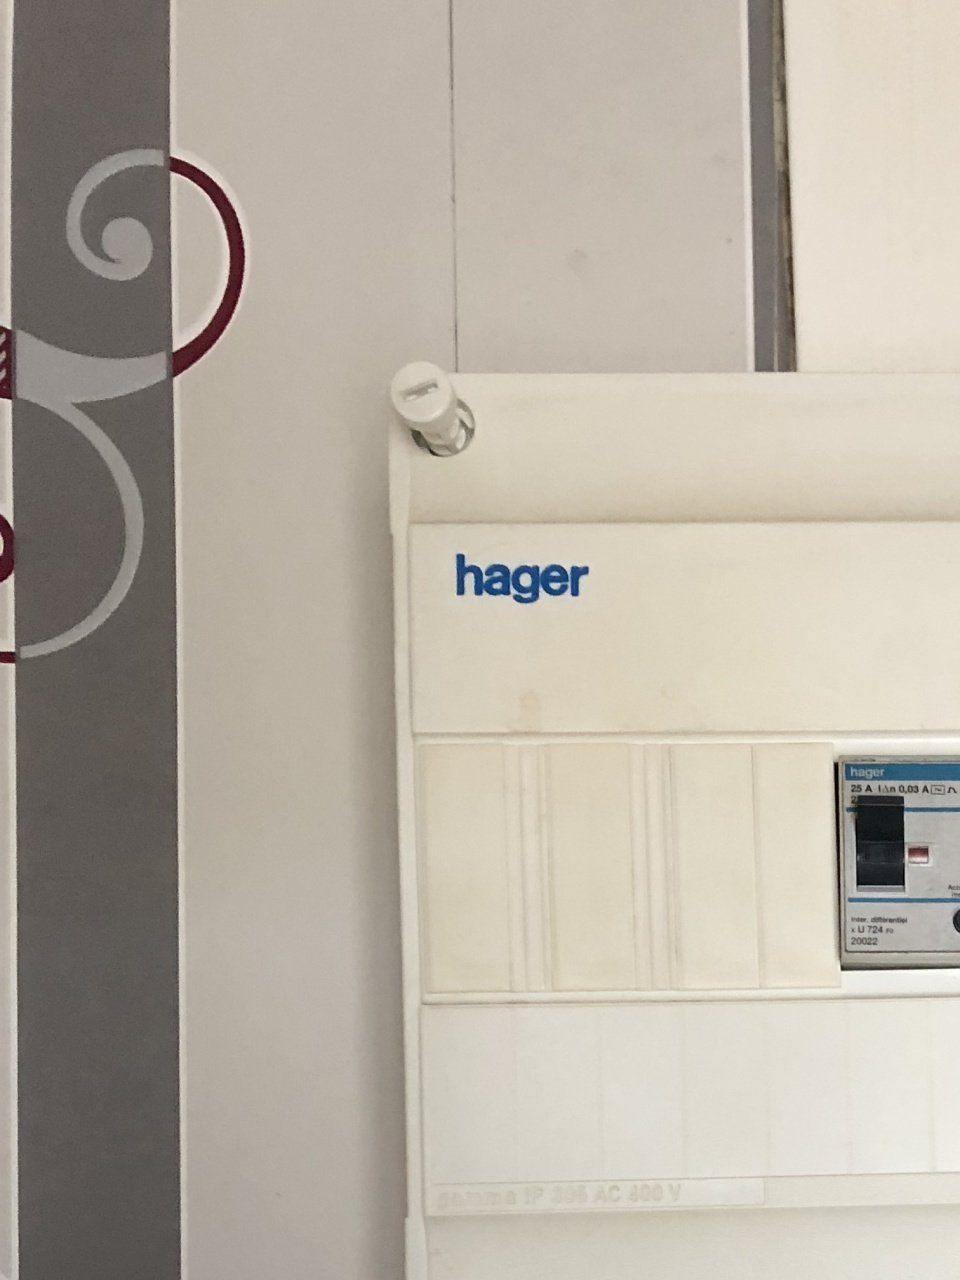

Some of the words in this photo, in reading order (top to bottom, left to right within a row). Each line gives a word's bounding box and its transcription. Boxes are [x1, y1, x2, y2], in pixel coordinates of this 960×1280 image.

[456, 554, 589, 603] hager
[851, 767, 885, 779] hager
[851, 784, 862, 792] 25
[899, 785, 919, 794] 0,03
[922, 785, 929, 793] A
[867, 926, 883, 934] 724
[851, 937, 878, 946] 20022
